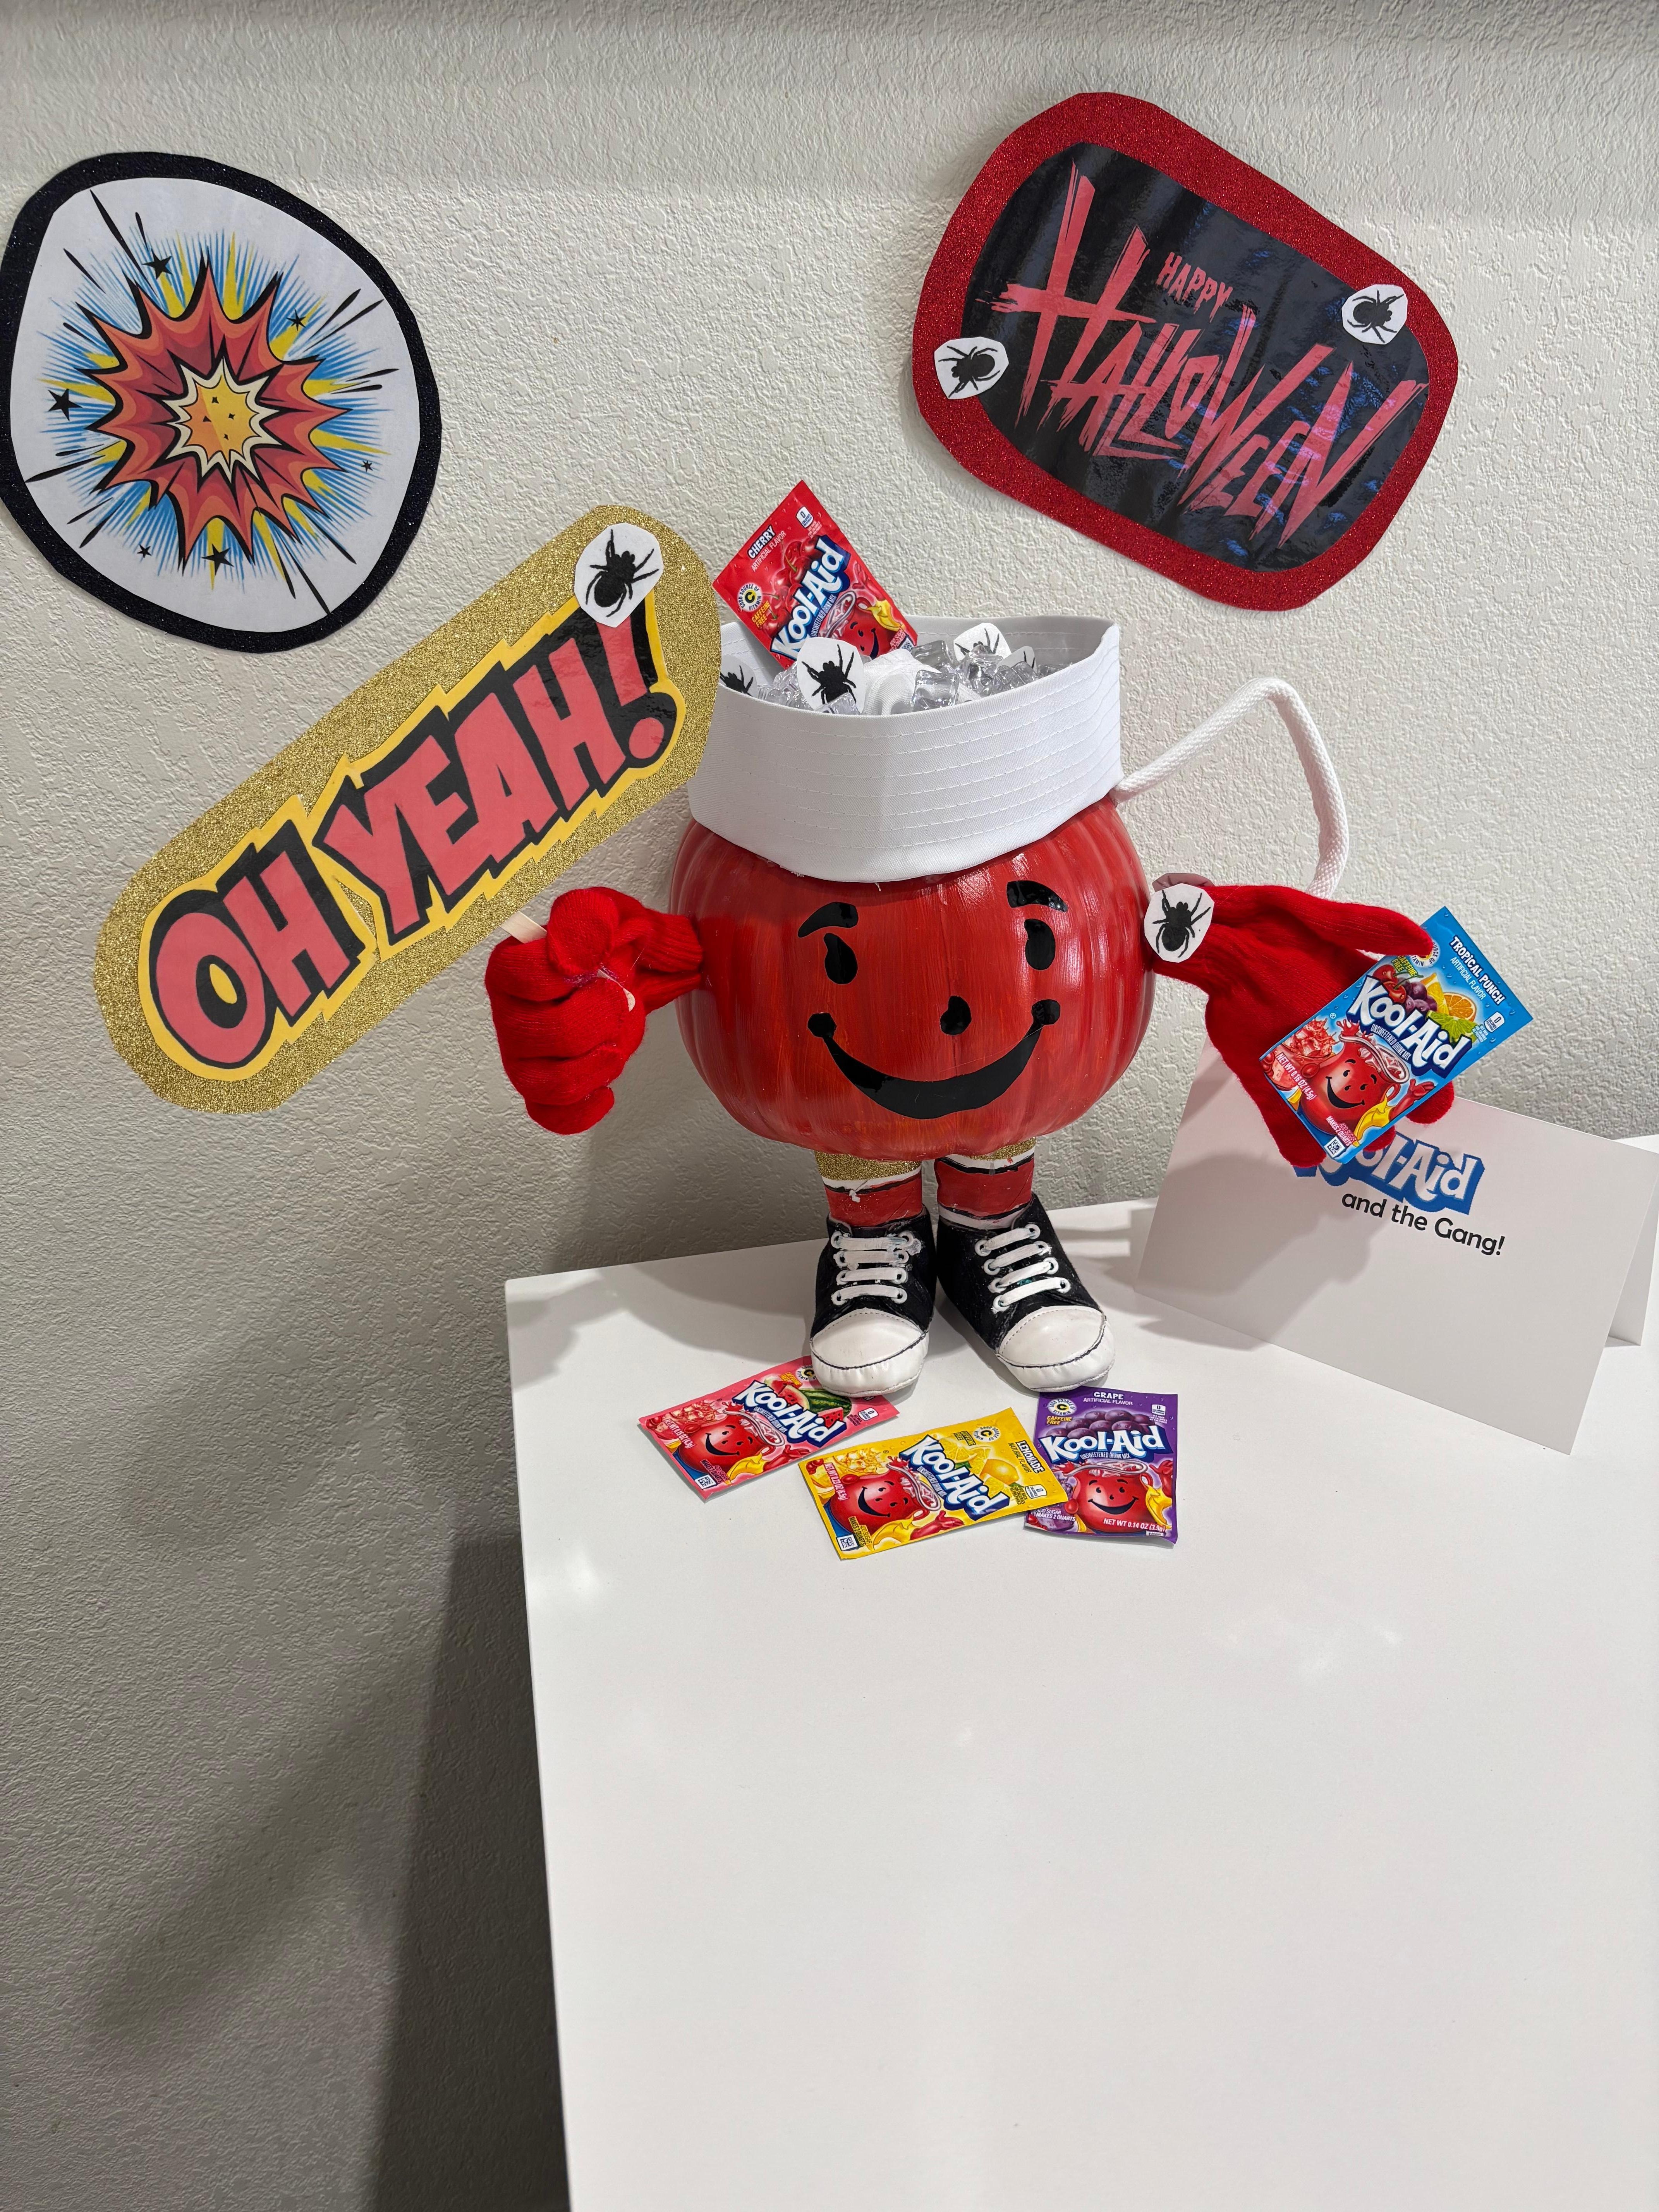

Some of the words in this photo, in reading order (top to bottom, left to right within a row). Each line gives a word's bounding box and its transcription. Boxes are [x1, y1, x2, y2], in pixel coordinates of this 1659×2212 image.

[1155, 252, 1233, 323] HAPPY
[976, 160, 1429, 548] HALLOWEEN
[748, 526, 775, 558] CHERRY
[751, 548, 772, 572] ARTIFICIAL
[769, 531, 787, 550] FLAVOR
[752, 600, 770, 623] CAFFEINE
[771, 538, 845, 659] Kool-Aid
[756, 614, 767, 628] FREE
[157, 853, 350, 1063] OH
[319, 615, 664, 936] YEAH!
[1412, 956, 1424, 967] TAMIN
[1450, 957, 1472, 983] ARTIFICIAL
[1469, 980, 1486, 1000] FLAVOR
[1479, 974, 1506, 1005] PUNCH
[1348, 977, 1472, 1069] Kool-Aid
[1370, 1024, 1397, 1045] UNSWEETENED
[1276, 1053, 1289, 1065] NET
[1284, 1062, 1295, 1073] WT
[1290, 1071, 1302, 1082] 0.16
[1298, 1079, 1307, 1089] OZ
[1326, 1116, 1340, 1130] MAKES
[1338, 1130, 1352, 1146] QUARTS
[1341, 1193, 1387, 1218] and
[1392, 1204, 1427, 1231] the
[1434, 1218, 1505, 1255] Gang!
[733, 1381, 845, 1442] Kool-Aid
[1094, 1391, 1124, 1400] GRAPE
[1008, 1443, 1023, 1458] NATURAL
[1017, 1441, 1044, 1473] LEMONADE
[1039, 1425, 1166, 1462] Kool-Aid
[900, 1436, 1009, 1513] Kool-Aid
[1149, 1524, 1165, 1532] (3.9g)
